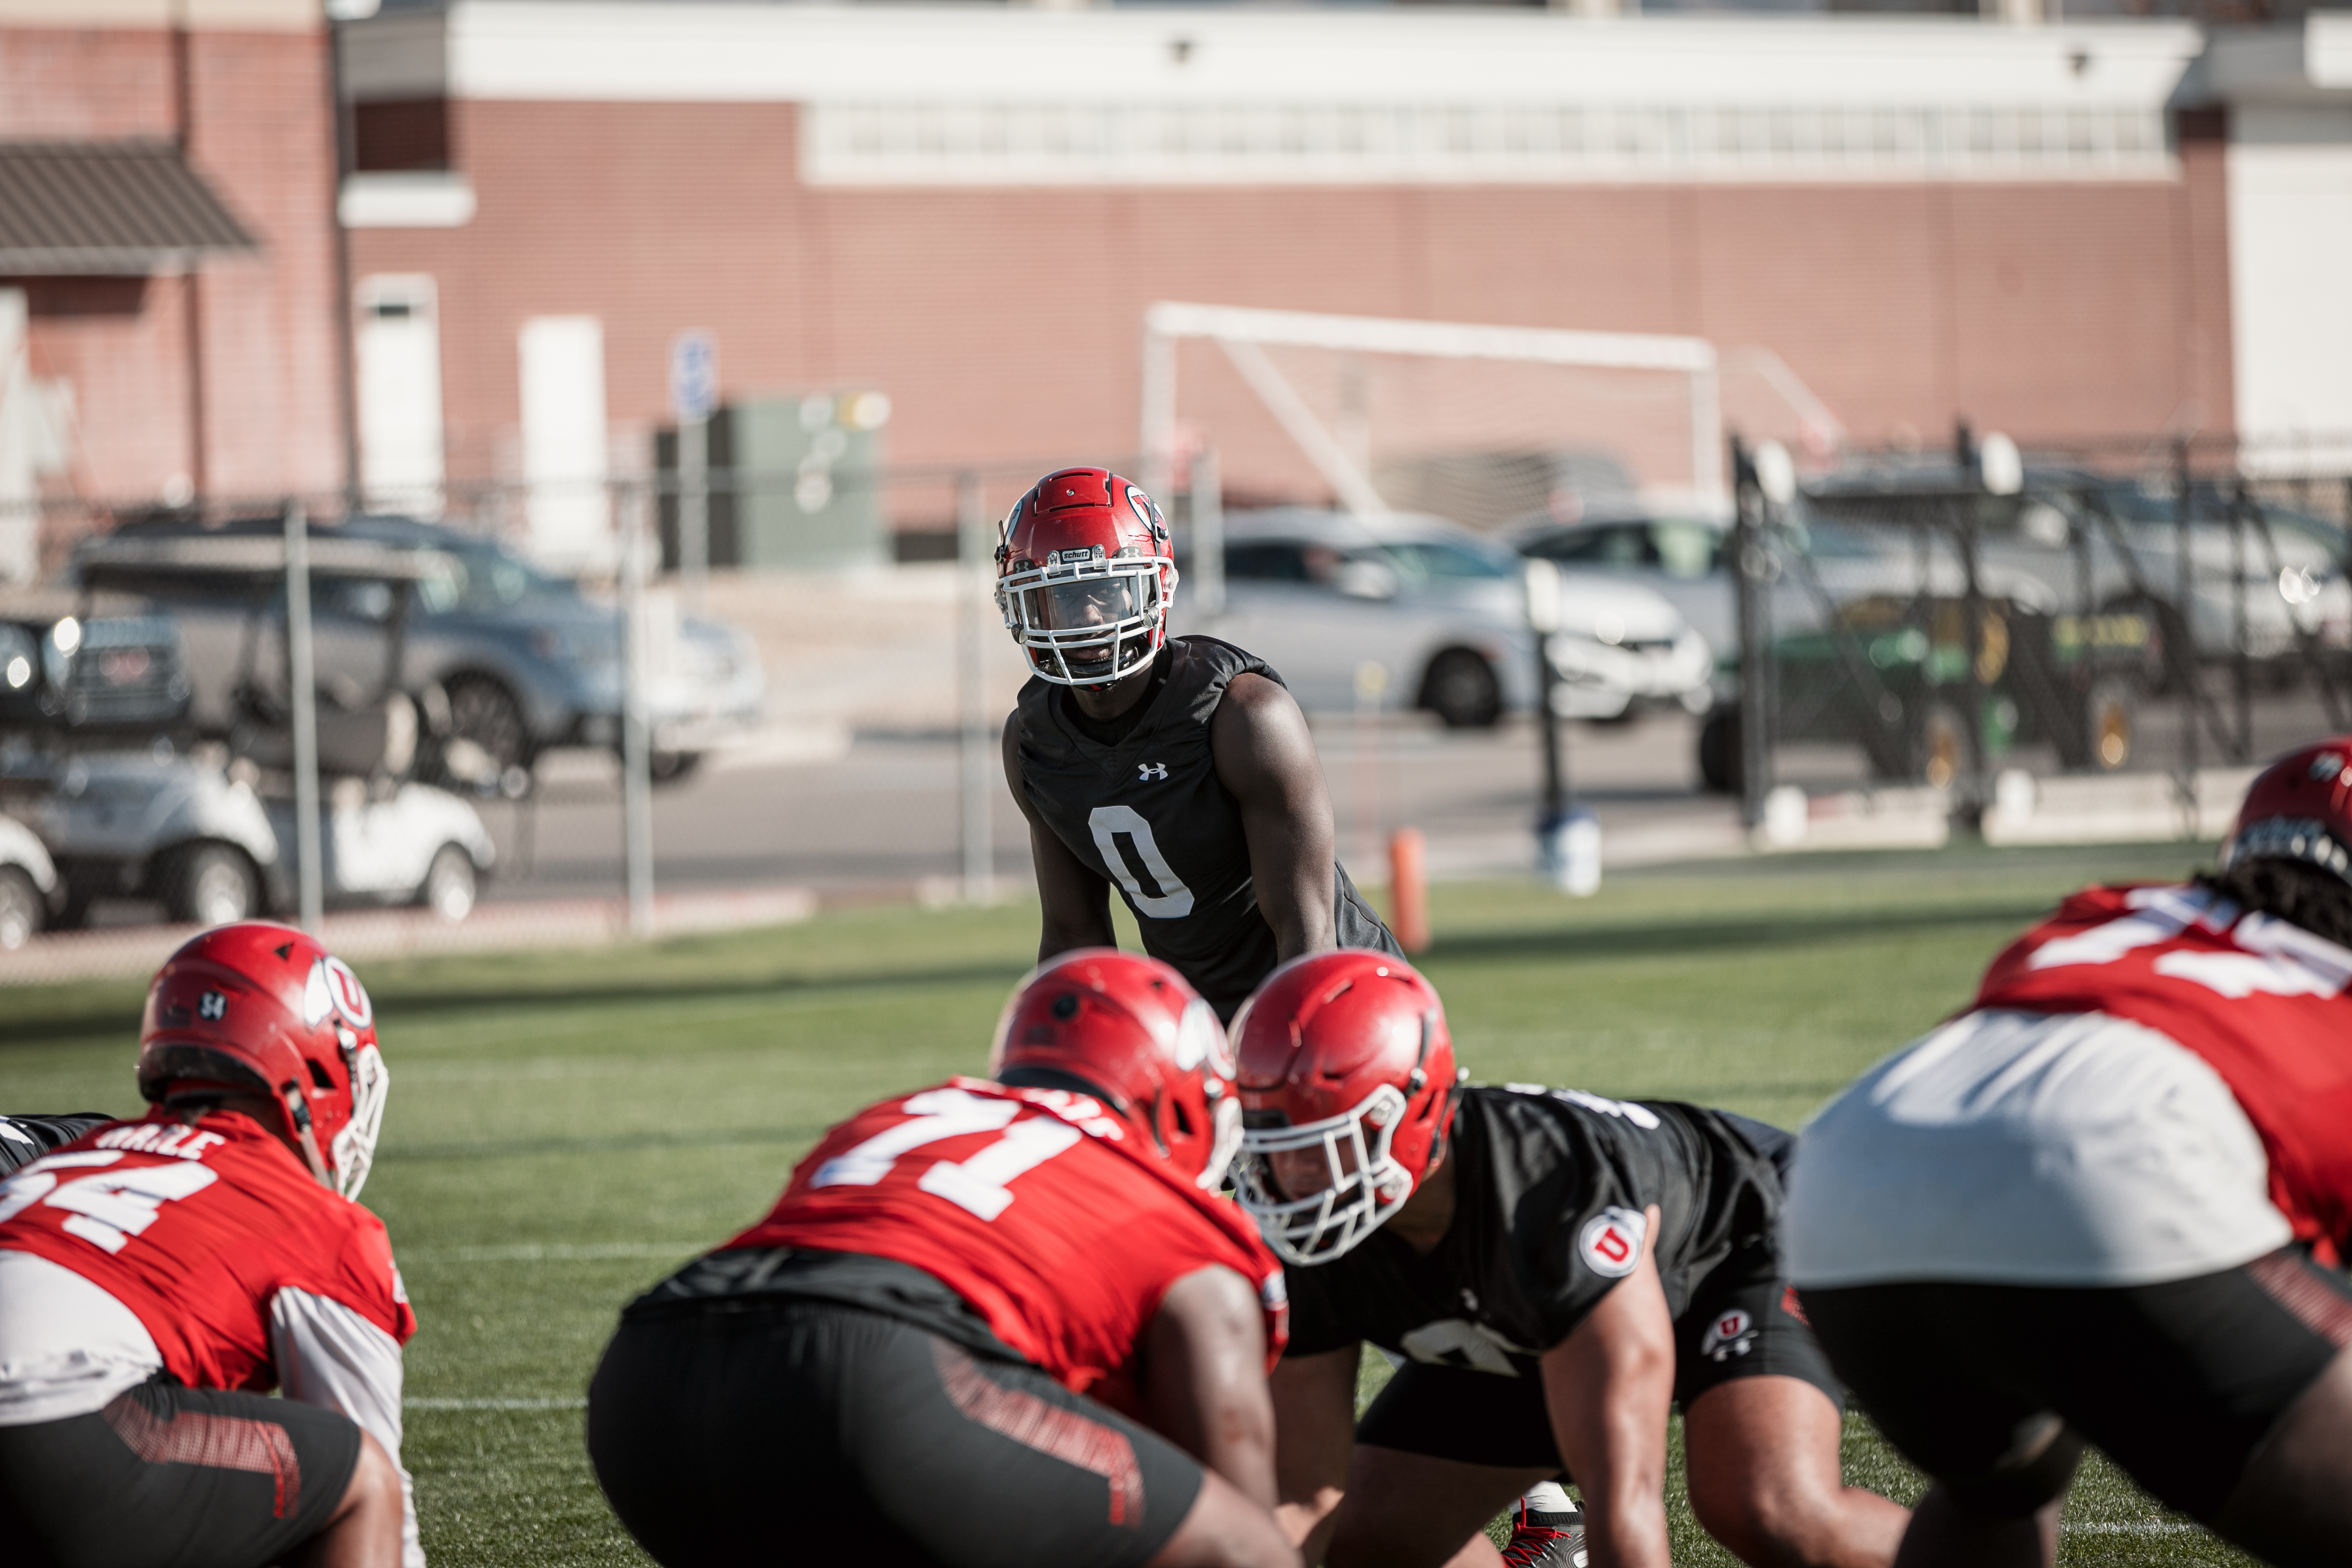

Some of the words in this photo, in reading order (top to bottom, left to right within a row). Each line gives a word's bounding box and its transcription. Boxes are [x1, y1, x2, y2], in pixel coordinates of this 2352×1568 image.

[1088, 806, 1195, 918] 0
[202, 992, 225, 1021] 54
[332, 966, 363, 1017] U
[809, 1088, 1082, 1221] 71
[1595, 1226, 1629, 1262] U
[1721, 1316, 1739, 1337] U
